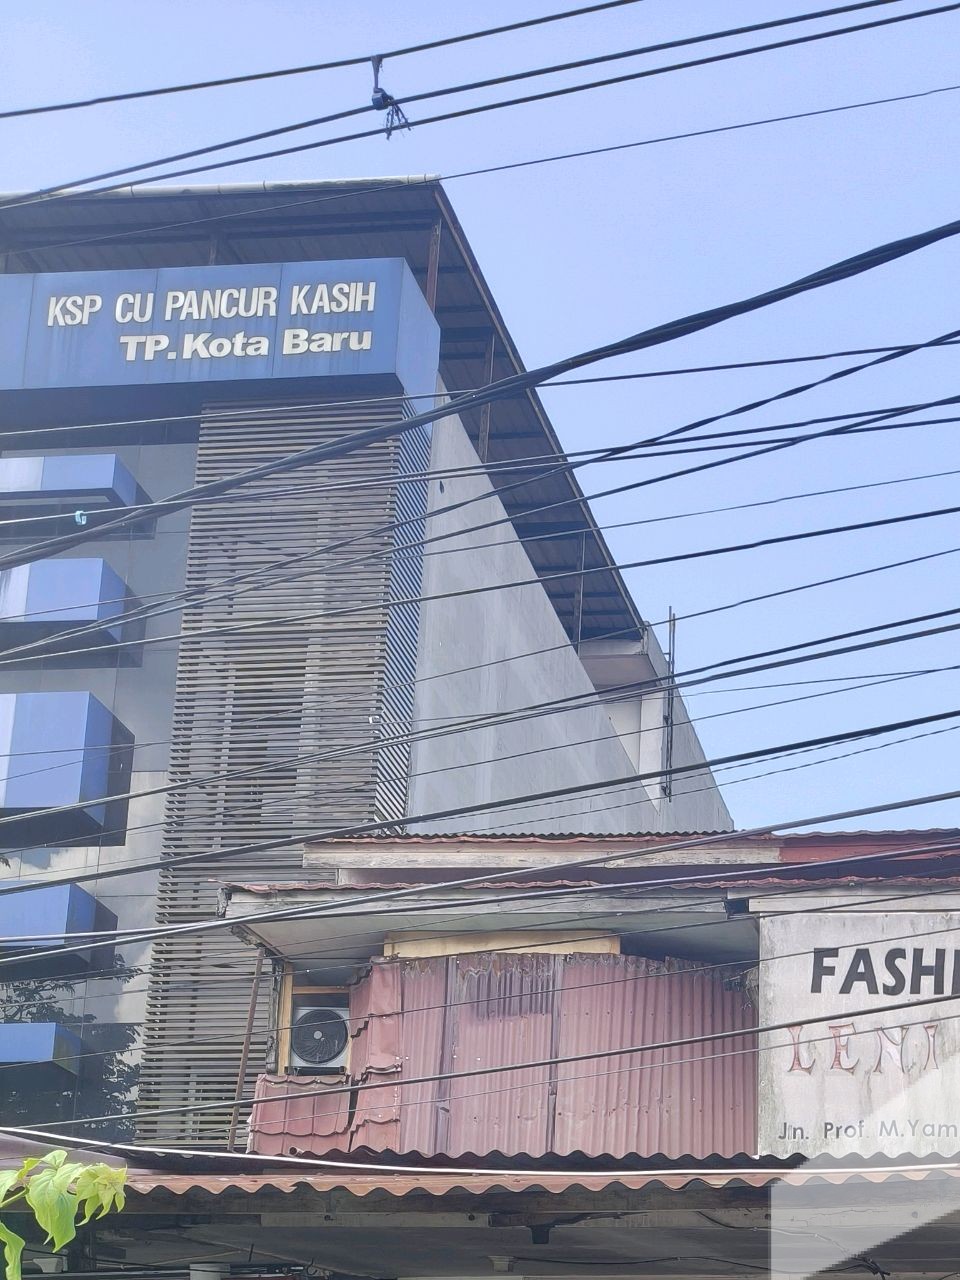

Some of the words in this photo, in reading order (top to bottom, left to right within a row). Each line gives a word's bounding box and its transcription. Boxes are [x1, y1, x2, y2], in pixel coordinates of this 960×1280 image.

[47, 295, 103, 327] KSP
[114, 292, 154, 324] CU
[164, 286, 278, 321] PANCUR
[290, 281, 376, 316] KASIH
[282, 328, 372, 355] Baru
